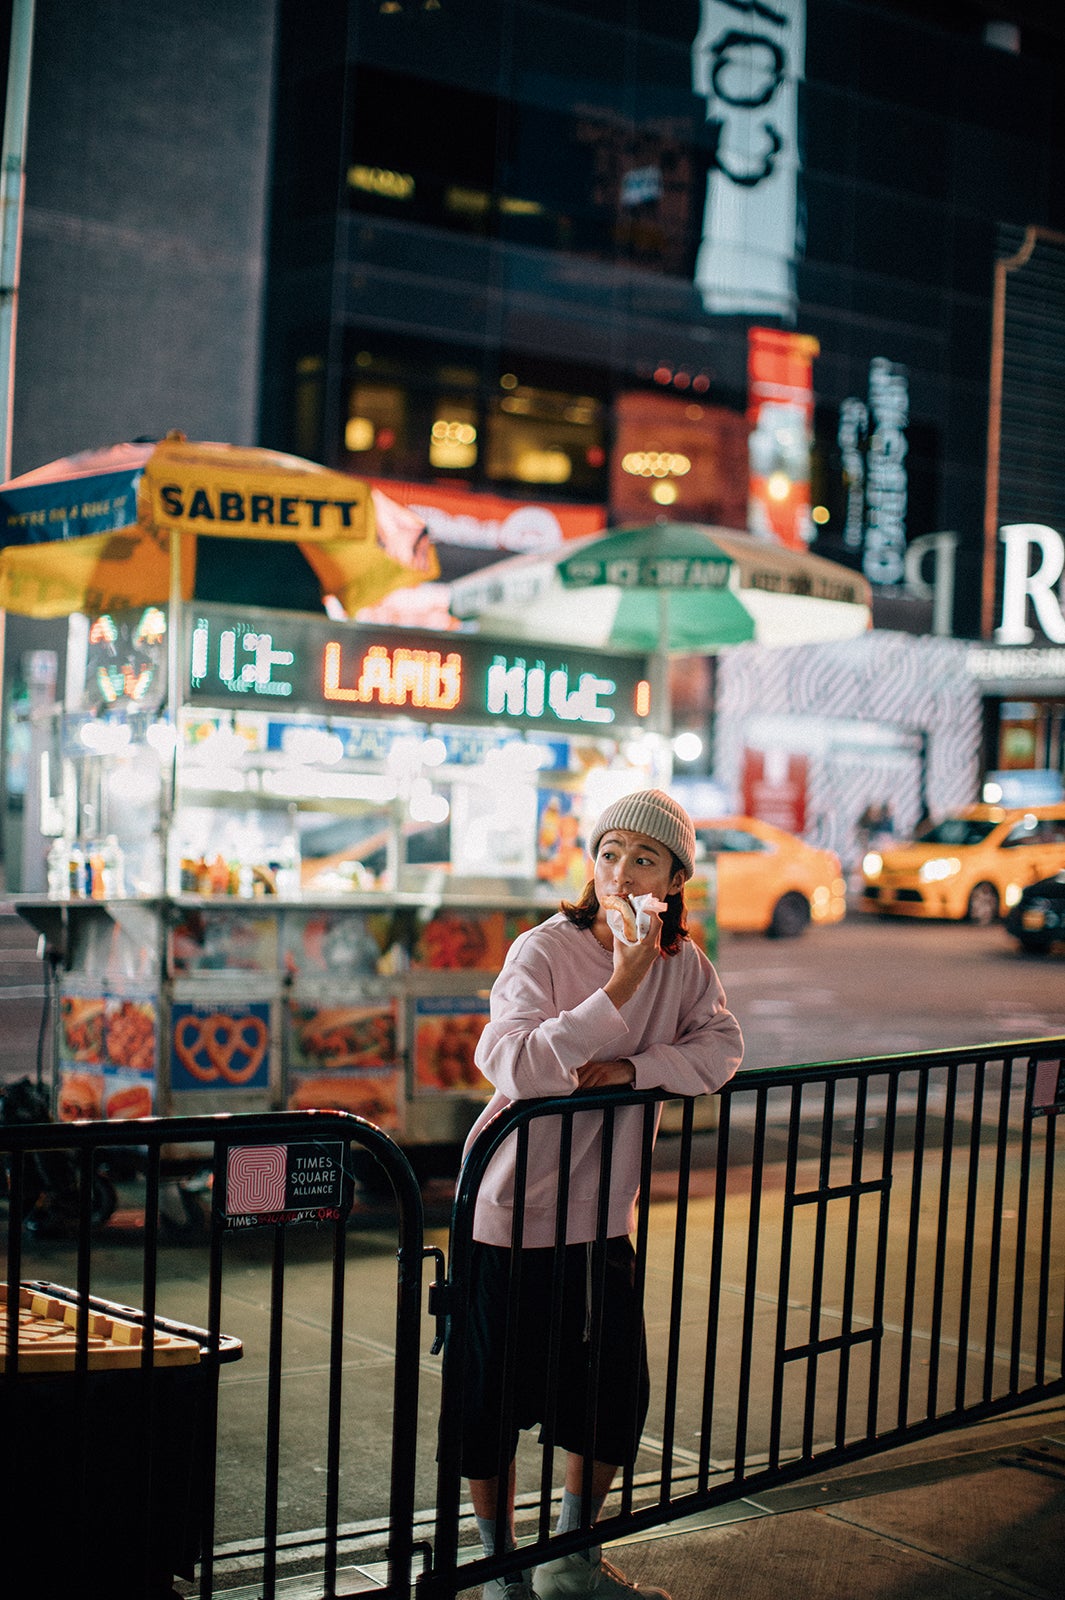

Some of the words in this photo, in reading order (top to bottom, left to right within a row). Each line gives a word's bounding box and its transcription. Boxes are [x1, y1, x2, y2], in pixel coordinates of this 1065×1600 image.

[160, 485, 358, 527] SABRETT
[296, 1156, 333, 1169] TIMES
[291, 1170, 336, 1185] SQUARE
[293, 1185, 334, 1196] ALLIANCE
